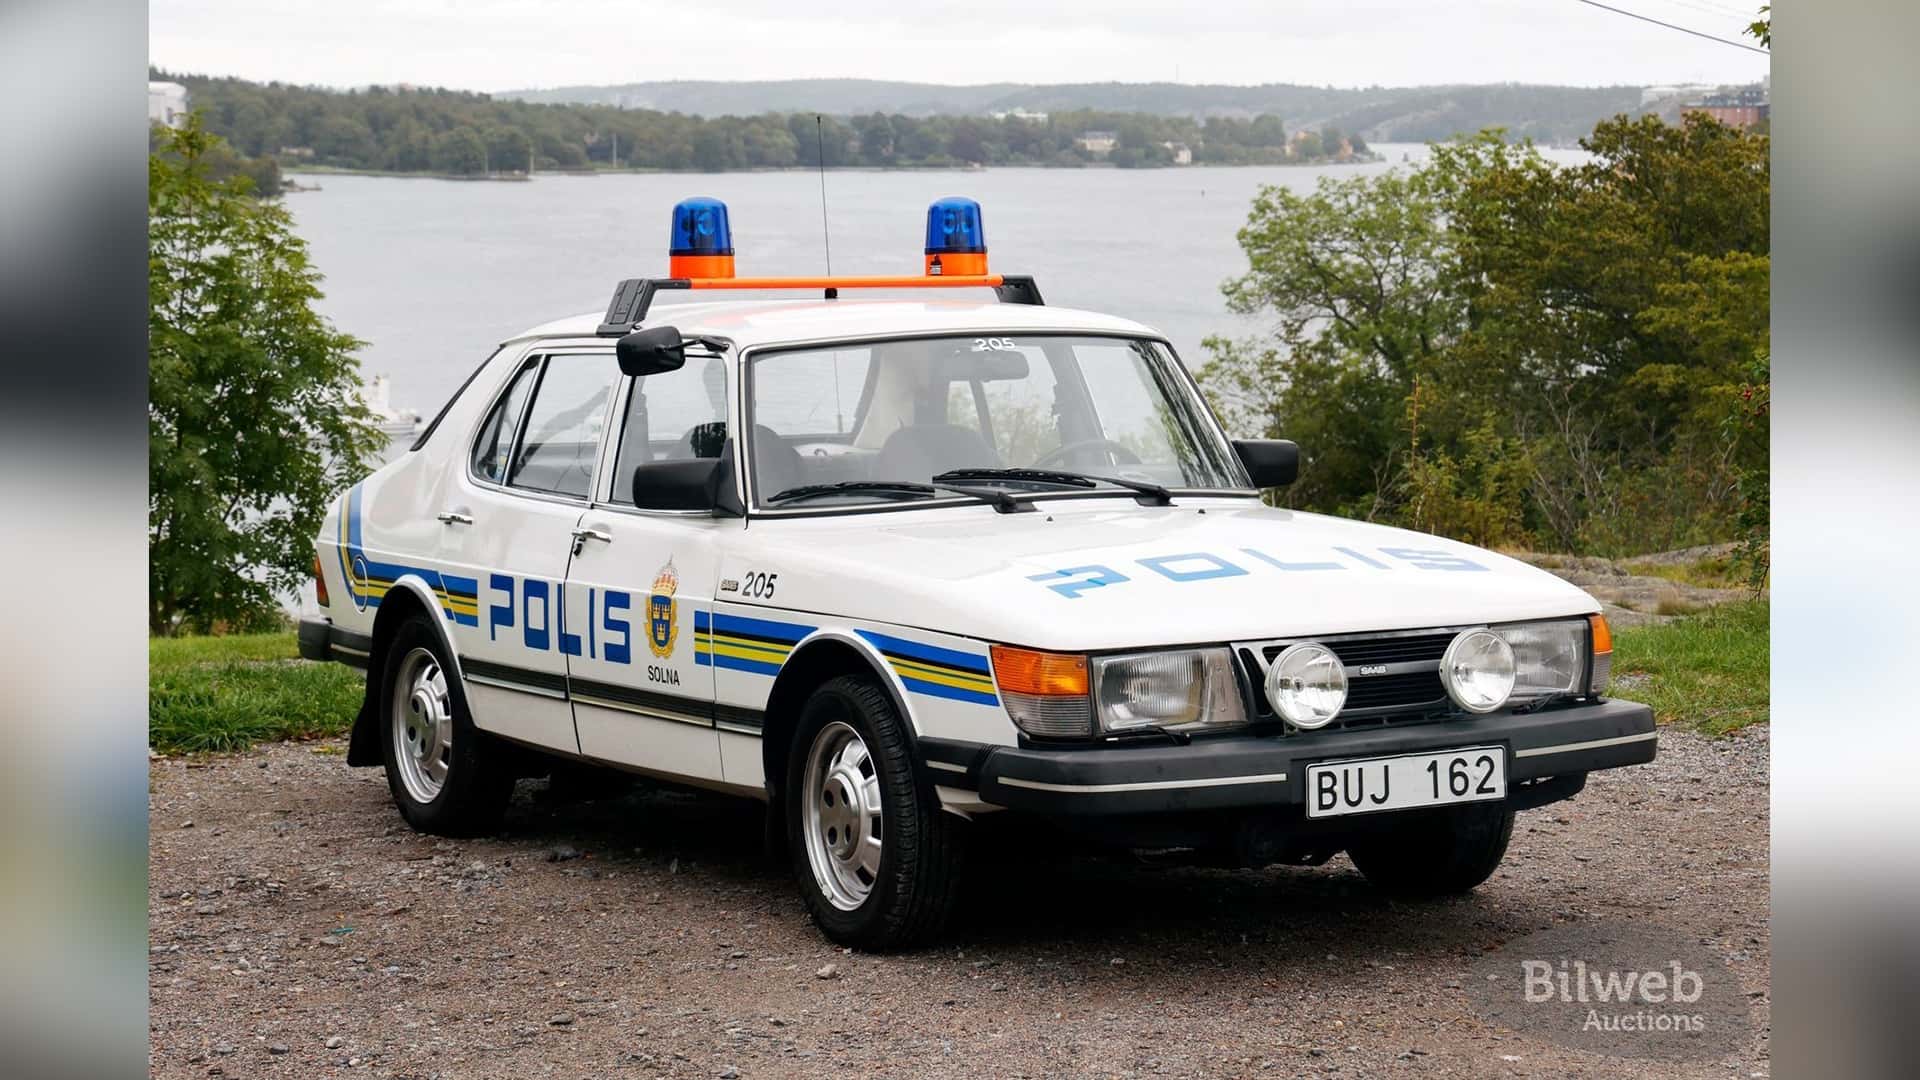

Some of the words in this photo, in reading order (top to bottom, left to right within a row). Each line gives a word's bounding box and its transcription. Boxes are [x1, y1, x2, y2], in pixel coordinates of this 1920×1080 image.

[975, 337, 1016, 351] 205
[742, 571, 778, 599] 205
[1024, 547, 1491, 599] POLIS
[490, 573, 631, 664] POLIS
[647, 665, 681, 686] SOLNA
[1317, 765, 1390, 811] BUJ
[1426, 755, 1496, 799] 162
